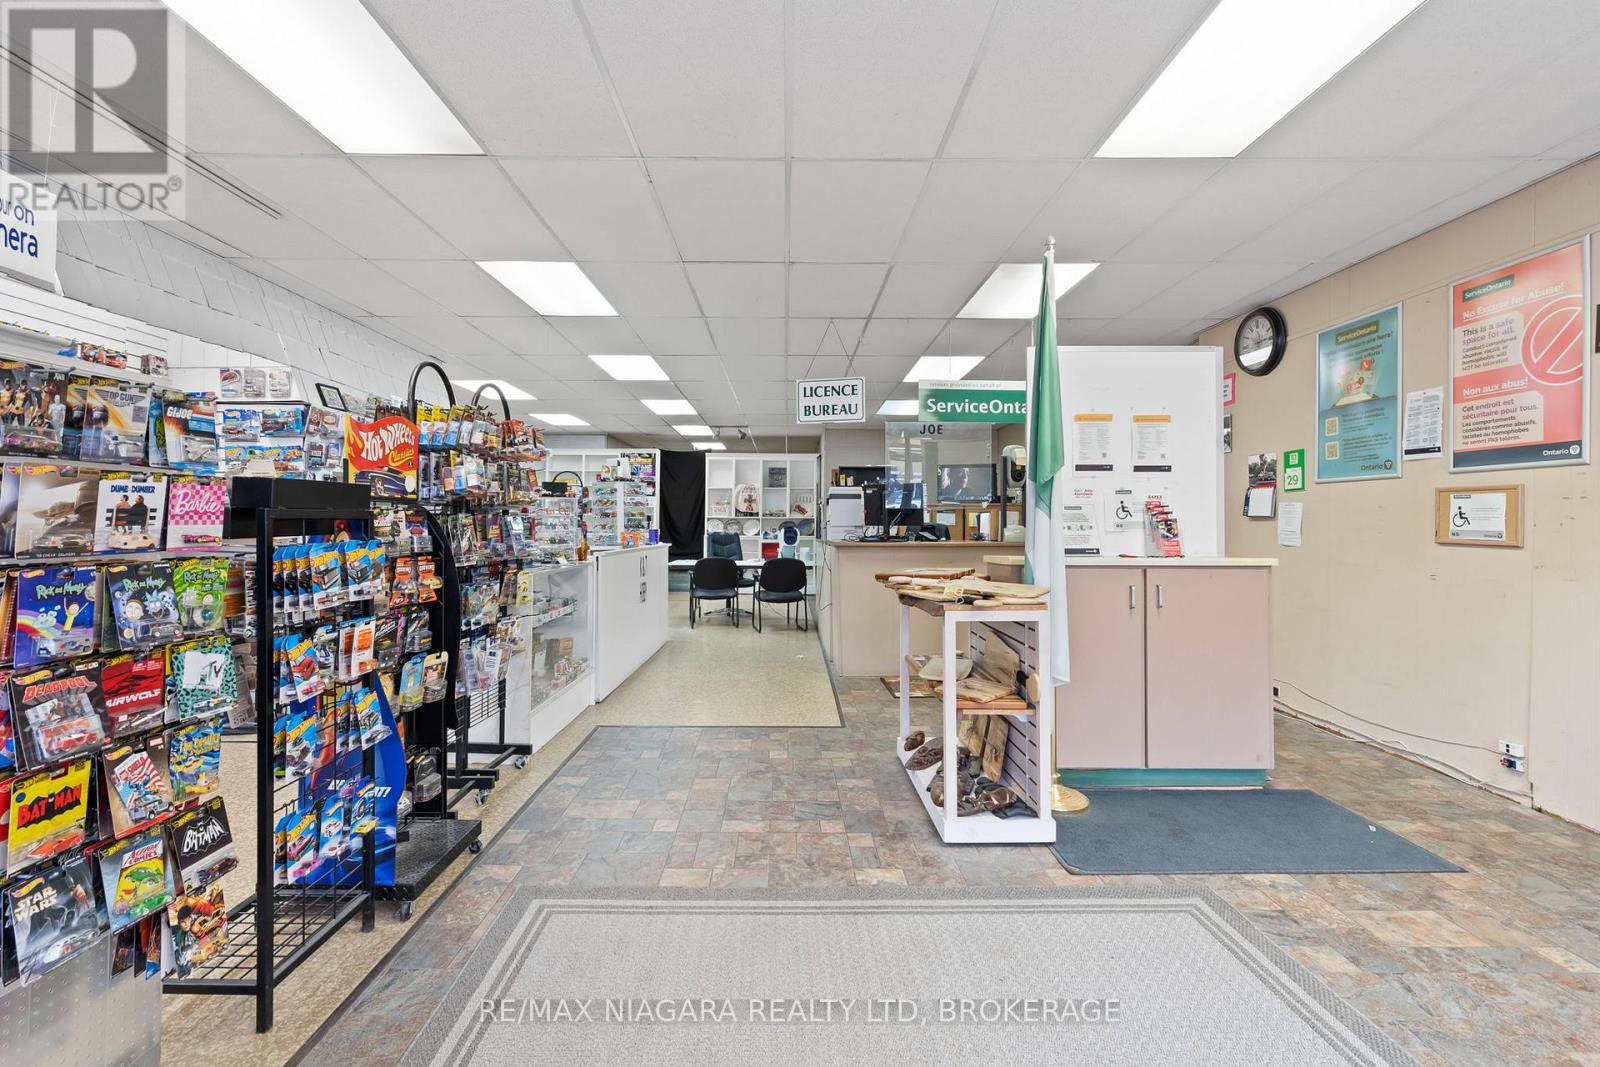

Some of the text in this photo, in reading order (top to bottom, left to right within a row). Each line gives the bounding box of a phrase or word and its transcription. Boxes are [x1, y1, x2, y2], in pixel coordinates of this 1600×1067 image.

[14, 205, 34, 226] on
[1462, 327, 1478, 337] This
[1495, 318, 1514, 329] safe
[1462, 334, 1486, 347] space
[1487, 330, 1500, 339] for
[803, 384, 859, 398] LICENCE
[1463, 376, 1528, 396] Non aux abus!
[107, 390, 134, 402] TOP GUN
[804, 403, 858, 417] BUREAU
[1462, 404, 1475, 413] Cet
[1475, 401, 1501, 411] endroit
[1500, 408, 1518, 417] pour
[920, 424, 944, 435] JOE
[1542, 448, 1570, 456] Ontario
[1287, 474, 1299, 486] 29
[175, 489, 222, 515] Barbie
[122, 578, 140, 592] Rick
[146, 576, 166, 589] Morty
[183, 571, 197, 583] Rick
[36, 584, 55, 600] Rick
[63, 580, 88, 596] Morty
[23, 675, 97, 703] DEADPOOL
[105, 689, 161, 707] AIRWOLF
[183, 819, 225, 852] BATMAN
[15, 886, 57, 913] STAR
[15, 893, 58, 922] WARS
